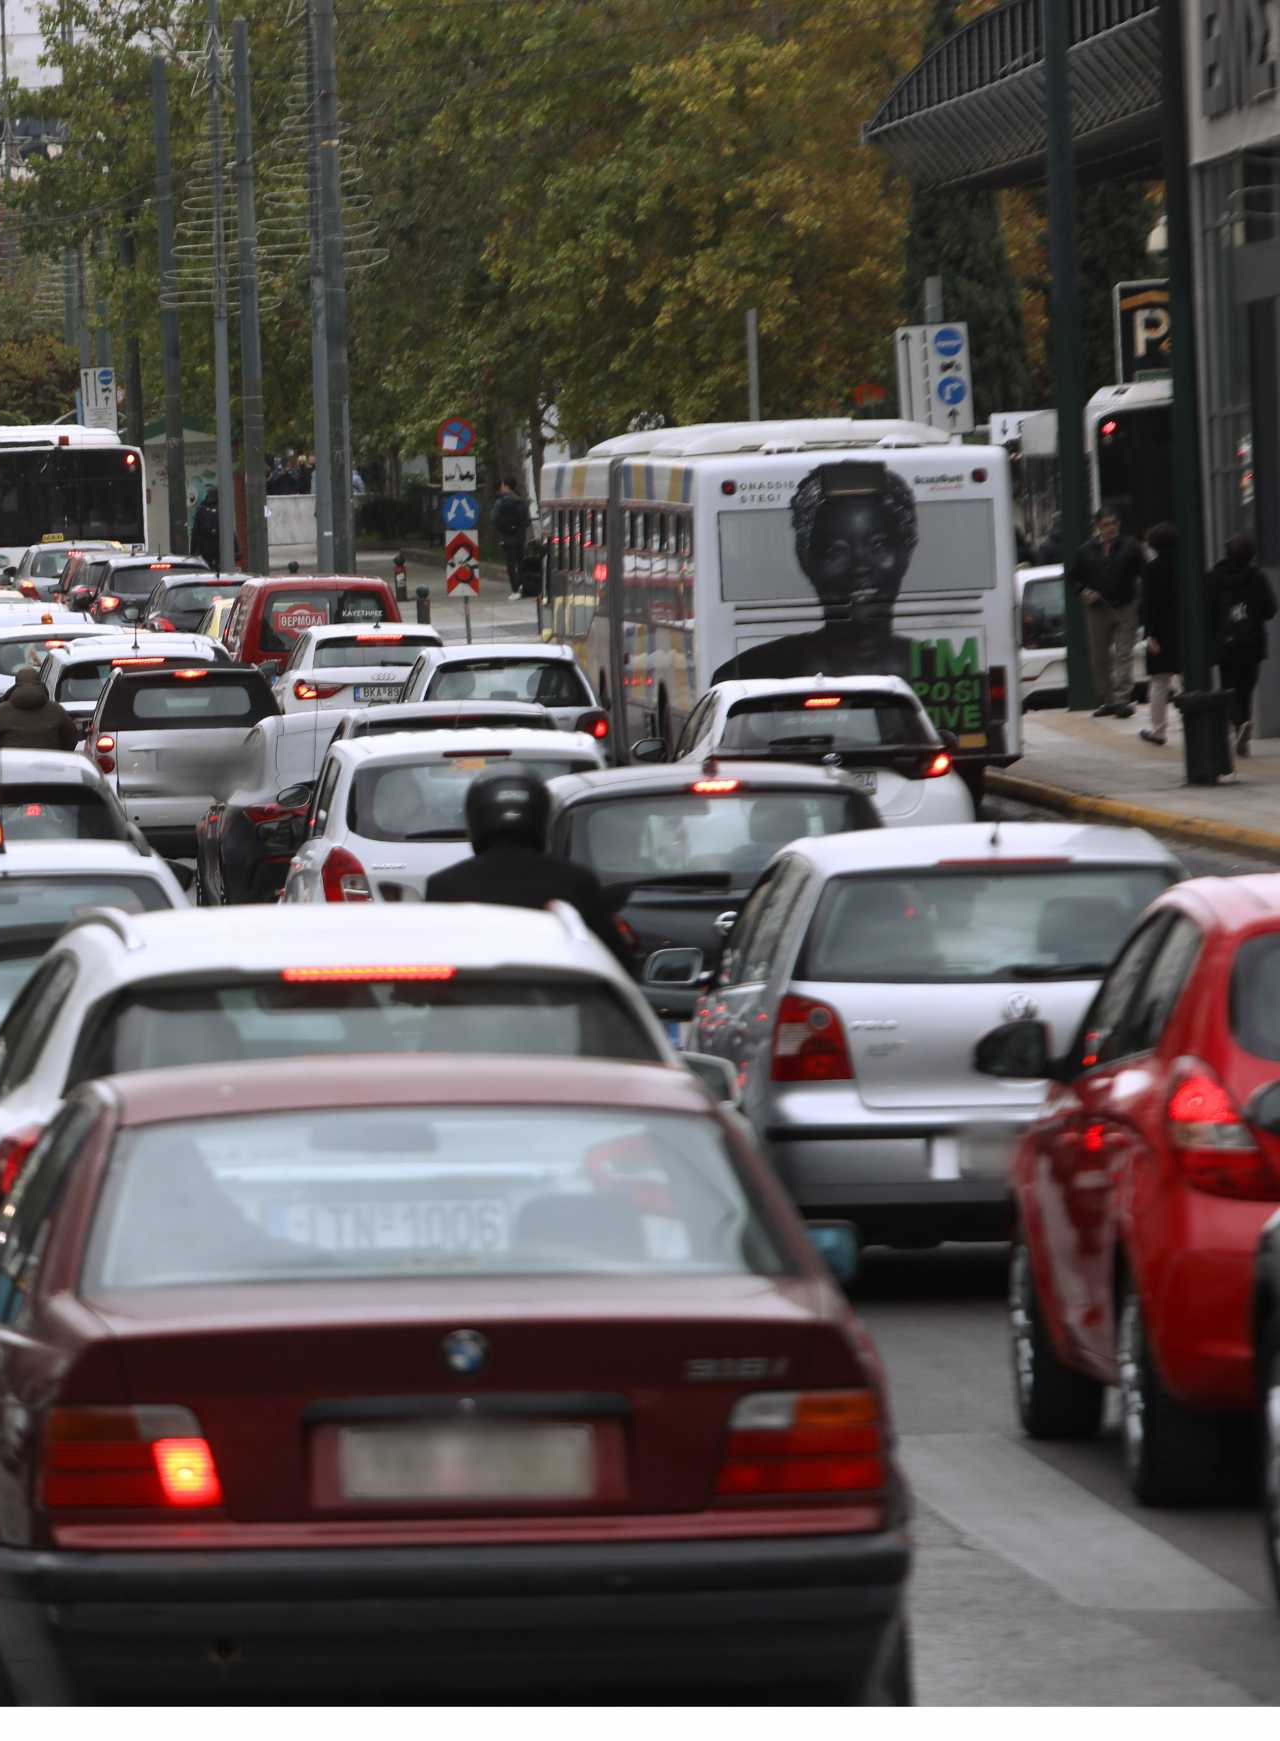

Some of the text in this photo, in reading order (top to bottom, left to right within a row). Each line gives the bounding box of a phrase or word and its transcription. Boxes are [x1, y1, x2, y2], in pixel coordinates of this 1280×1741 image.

[740, 493, 781, 503] STEGI
[280, 615, 323, 627] ΘΕΡΜΟΛΑ
[911, 636, 978, 678] I'M
